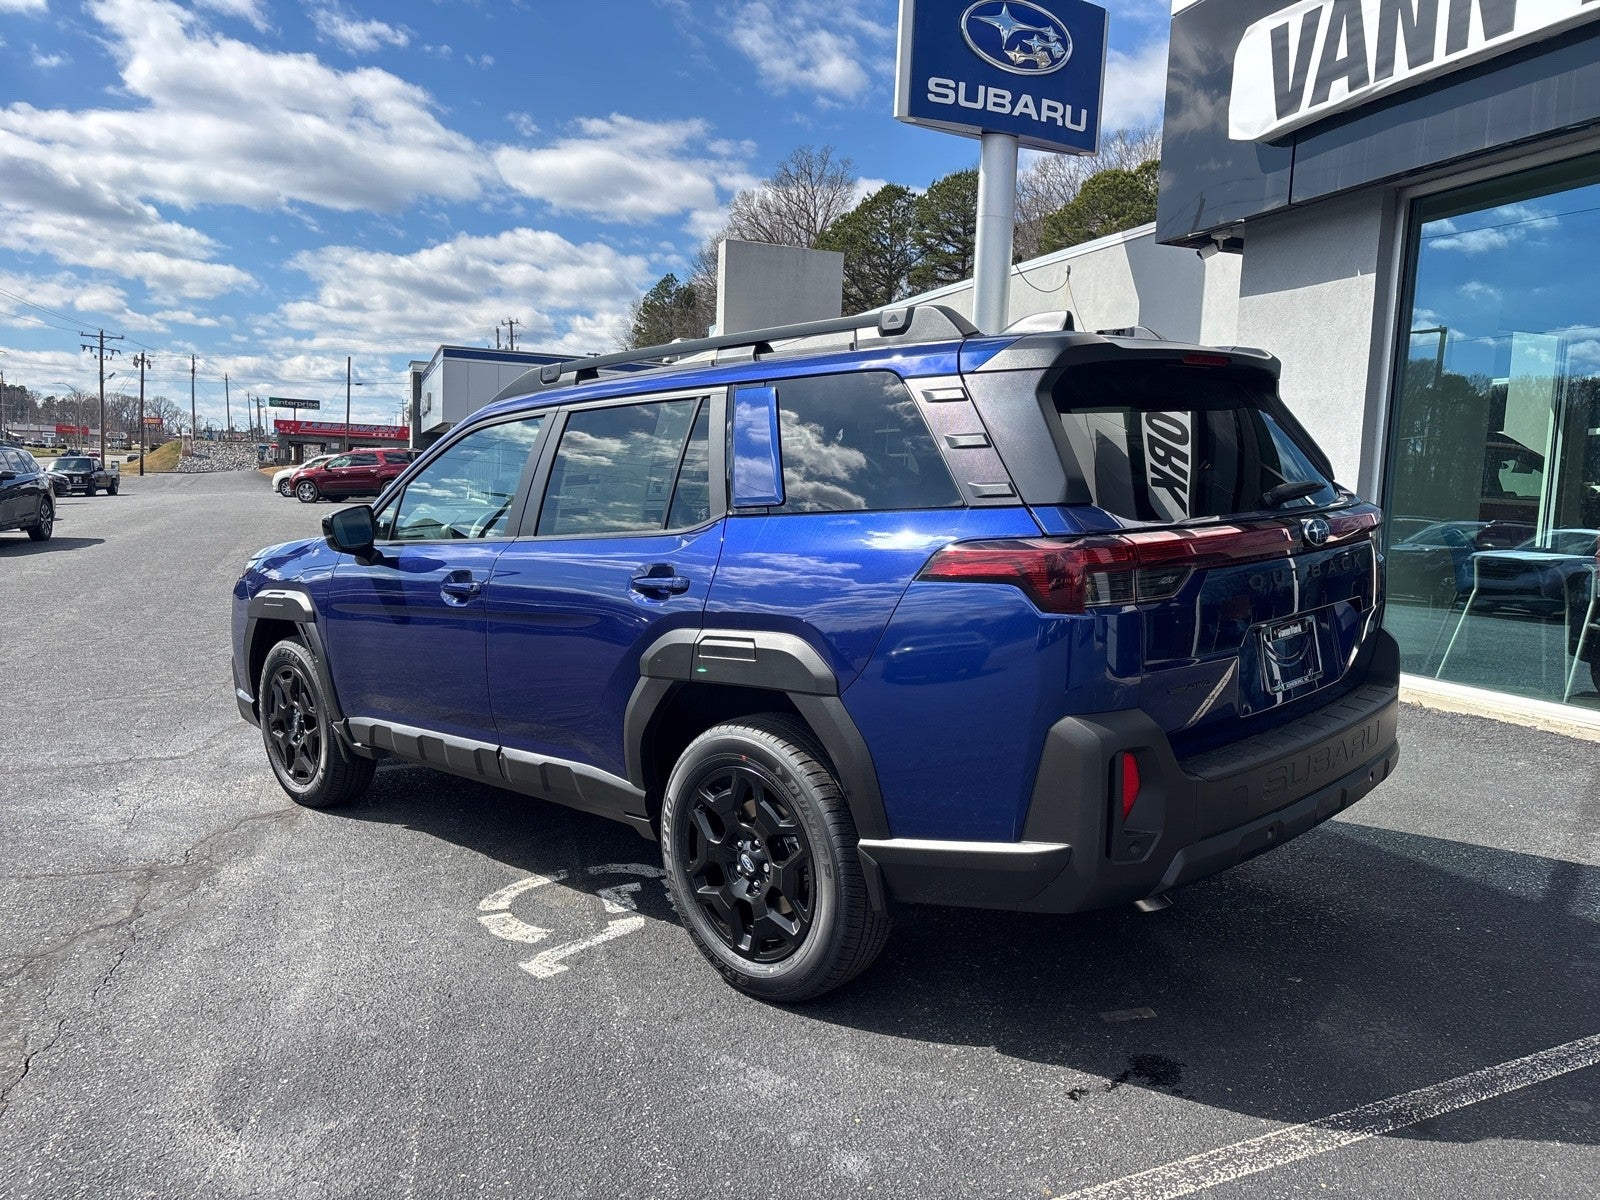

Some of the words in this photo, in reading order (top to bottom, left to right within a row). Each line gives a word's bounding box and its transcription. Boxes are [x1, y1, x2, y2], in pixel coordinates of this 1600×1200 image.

[927, 76, 1088, 132] SUBARU
[271, 399, 319, 409] enterprise
[1262, 719, 1381, 801] SUBARU
